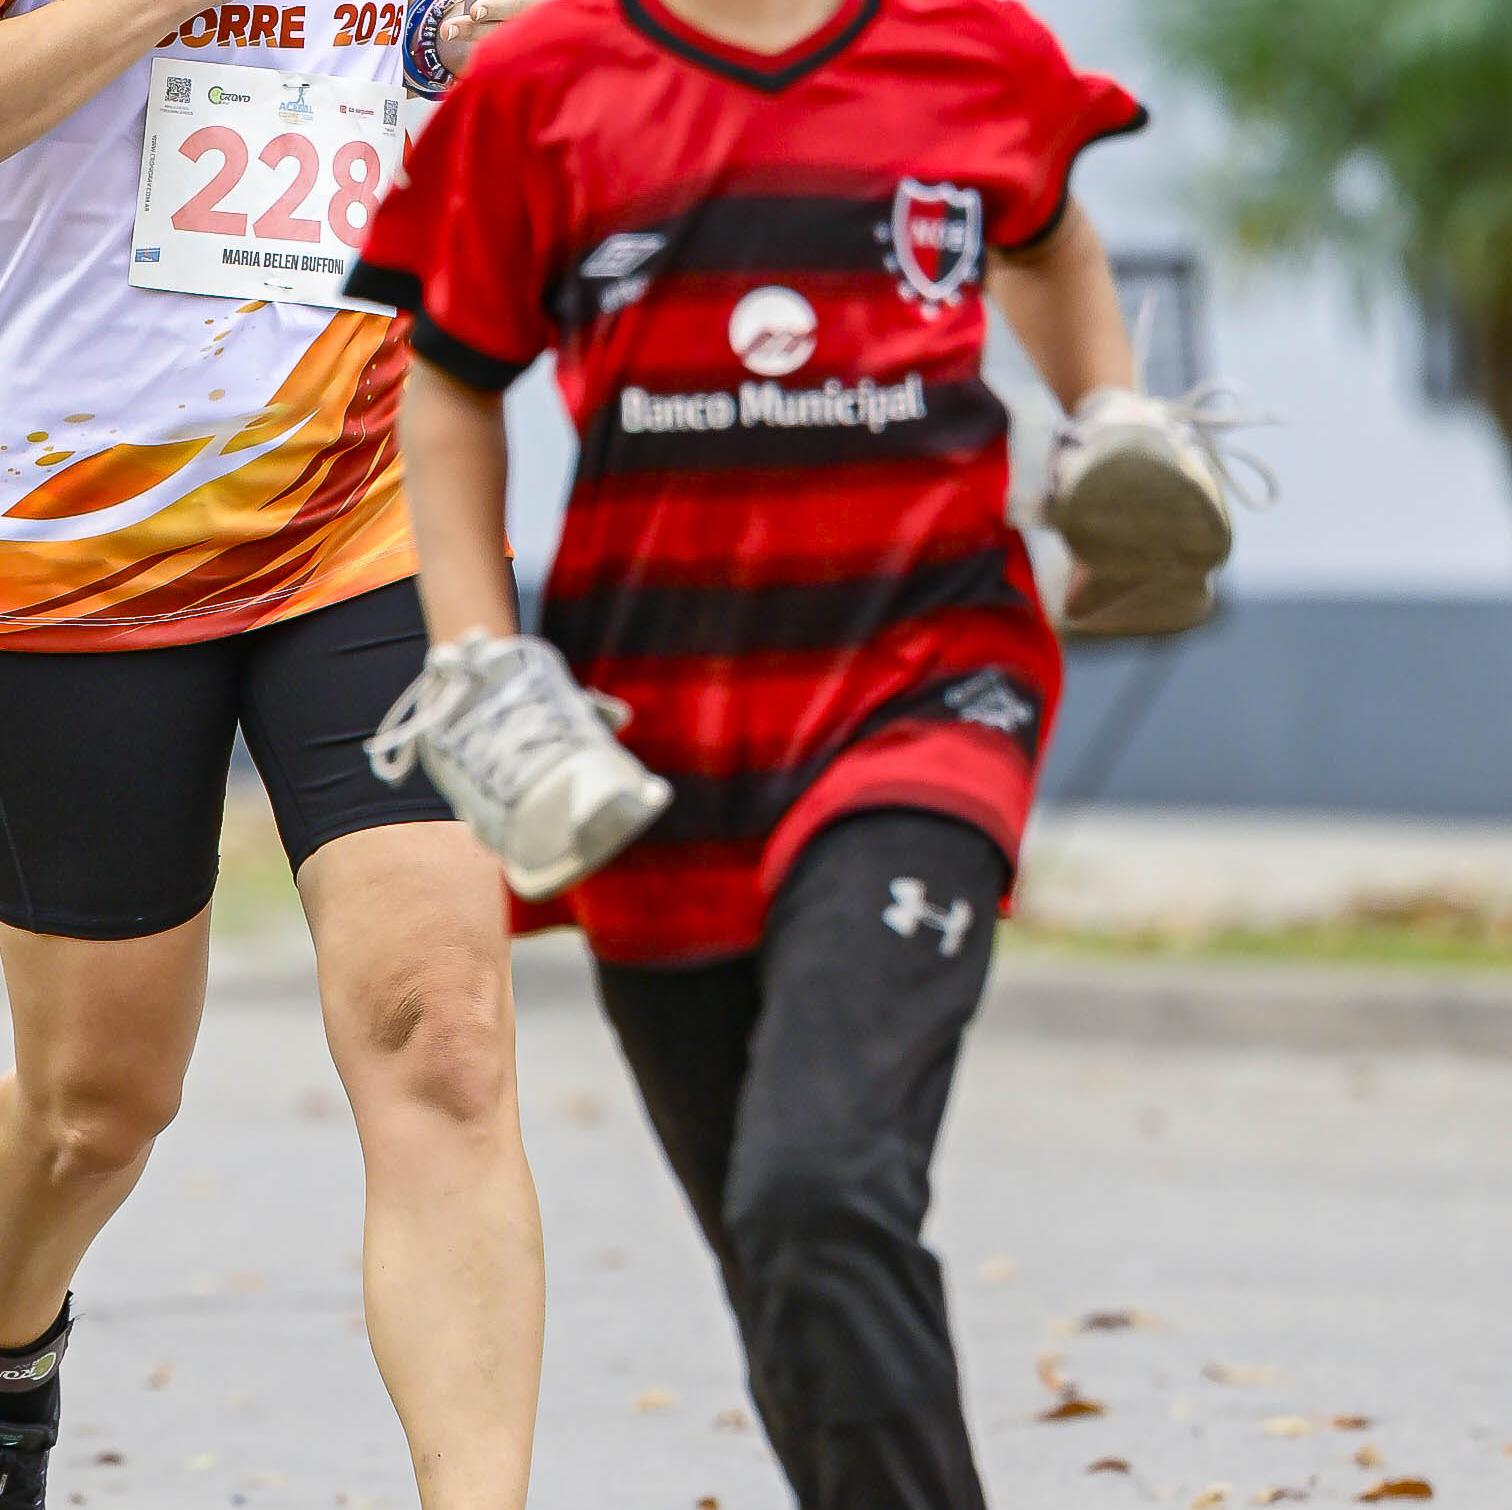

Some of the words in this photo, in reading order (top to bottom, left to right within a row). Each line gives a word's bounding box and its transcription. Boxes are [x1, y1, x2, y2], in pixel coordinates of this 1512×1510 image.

[333, 2, 404, 47] 2026
[170, 125, 381, 249] 228
[222, 248, 261, 267] MARIA
[263, 252, 299, 270] BELEN
[301, 255, 345, 275] BUFFONI
[620, 386, 737, 433] Banco
[738, 369, 928, 434] Municipal
